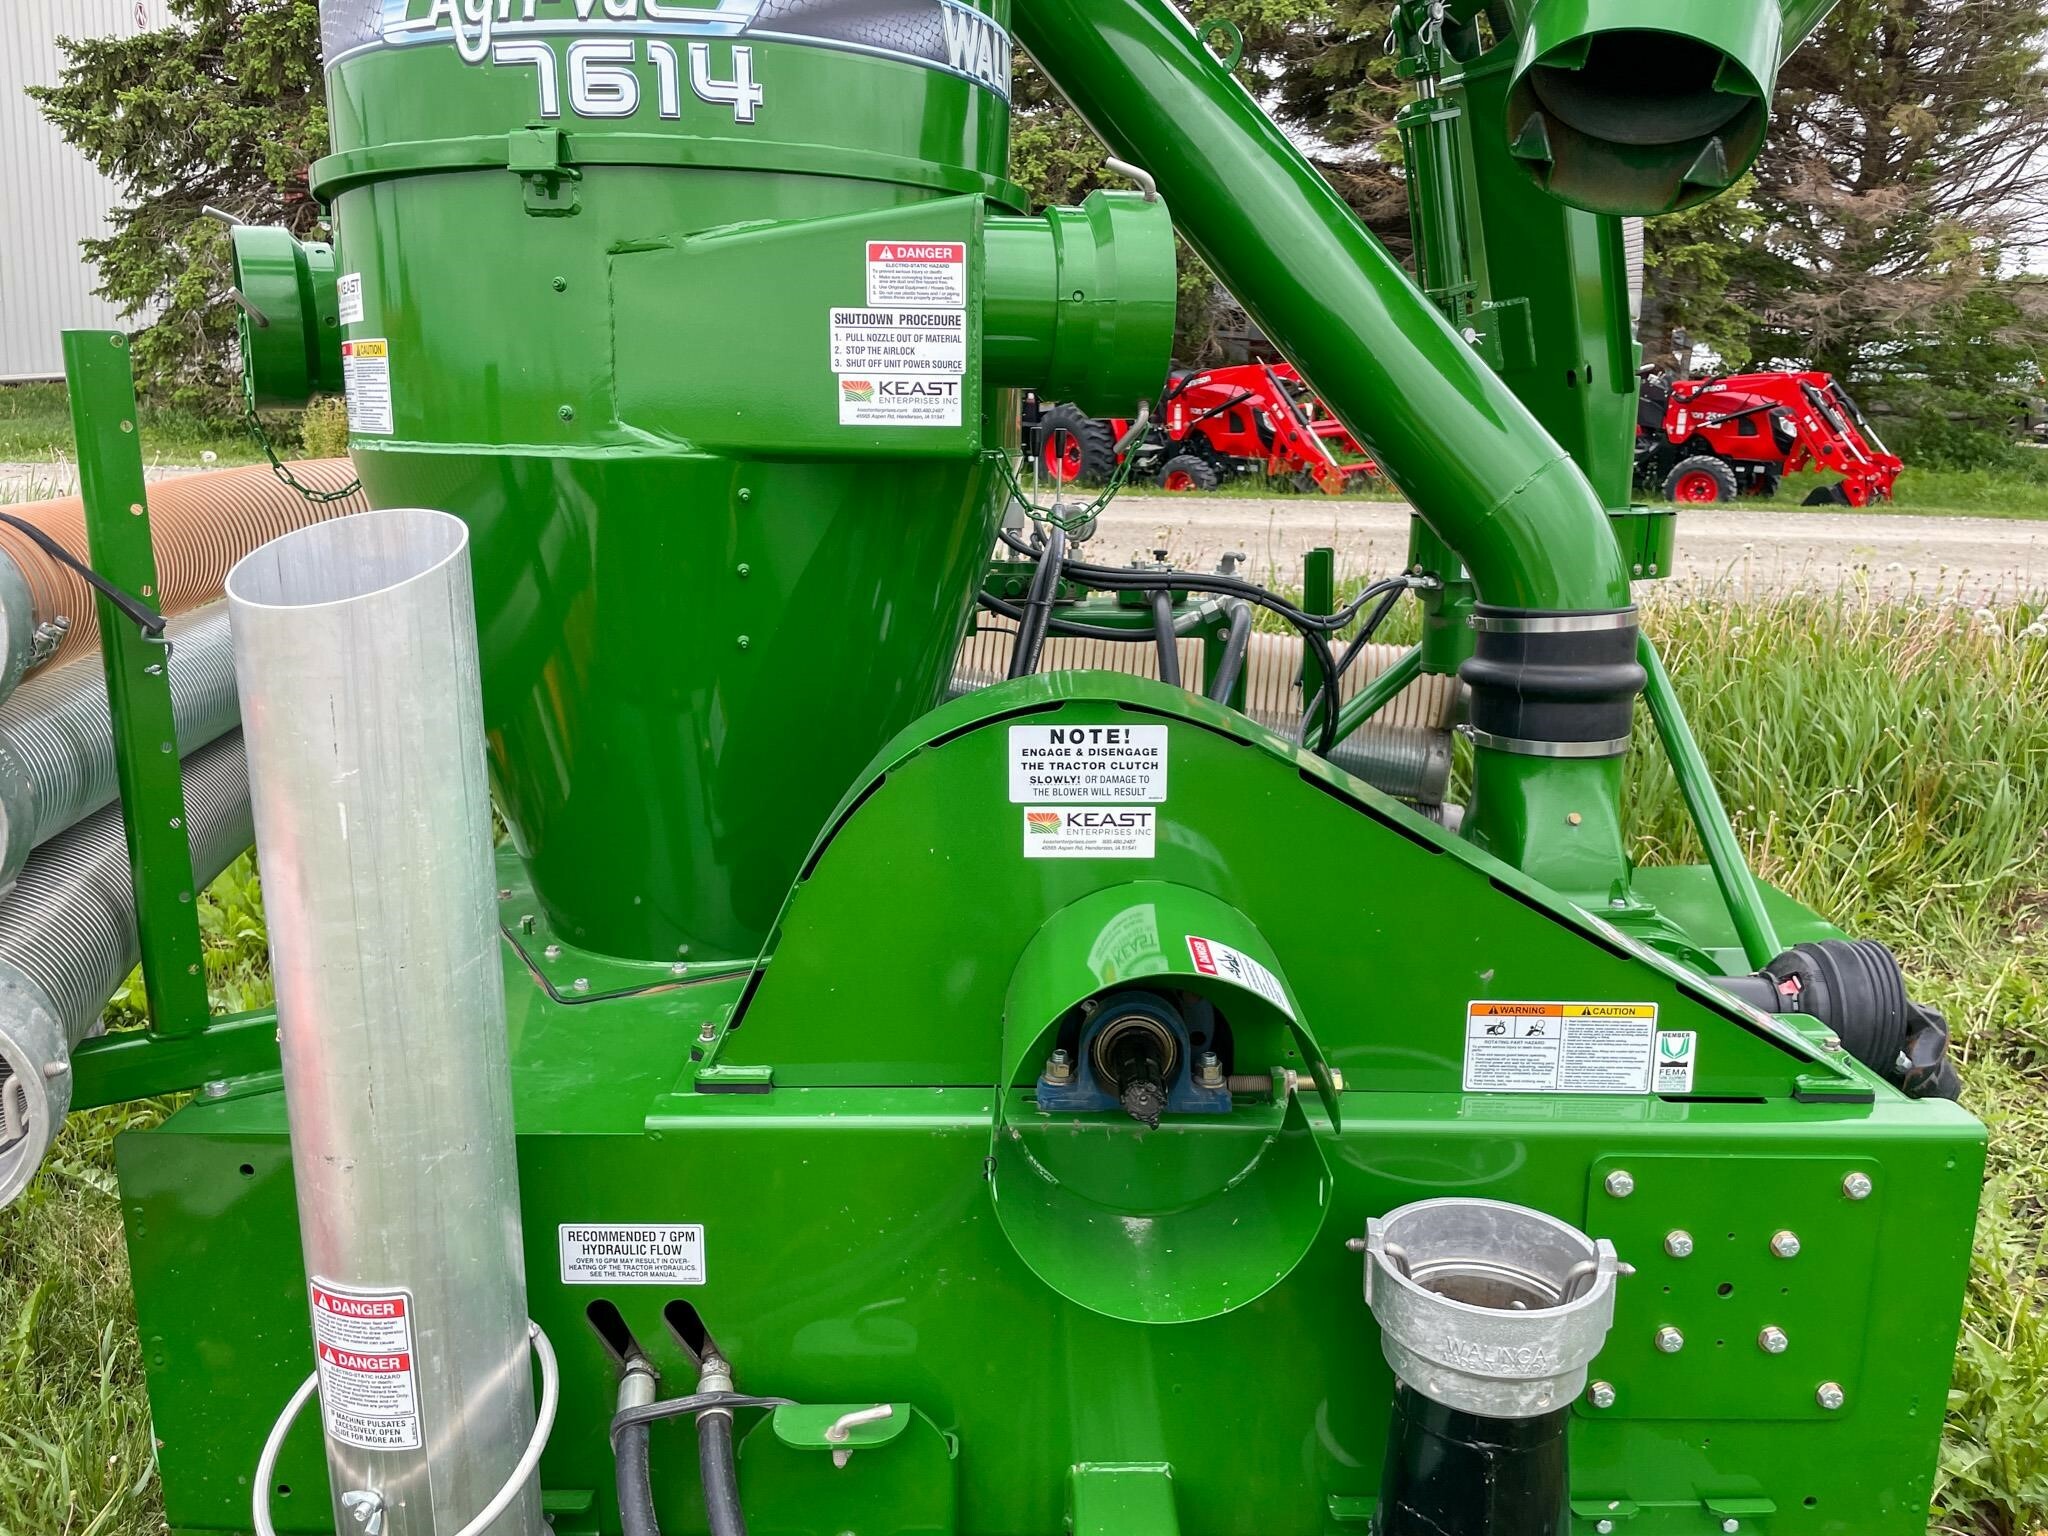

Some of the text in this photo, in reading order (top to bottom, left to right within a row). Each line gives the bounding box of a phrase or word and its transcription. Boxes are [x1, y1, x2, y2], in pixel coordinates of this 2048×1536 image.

[492, 39, 763, 122] 7614
[896, 247, 953, 259] DANGER
[834, 313, 962, 326] SHUTDOWN PROCEDURE
[834, 333, 962, 343] 1. PULL NOZZLE OUT OF MATERIAL
[834, 346, 916, 355] 2. STOP THE AIRLOCK
[834, 359, 962, 369] 3. SHUT OFF UNIT POWER SOURCE
[879, 381, 958, 396] KEAST
[1050, 728, 1130, 744] NOTE!
[1022, 748, 1158, 756] ENGAGE & DISENGAGE
[1021, 762, 1159, 770] THE TRACTOR CLUTCH
[1029, 776, 1150, 784] SLOWLY! OR DAMAGE TO
[1034, 788, 1146, 796] THE BLOWER WILL RESULT
[1067, 813, 1152, 827] KEAST
[1194, 940, 1211, 963] DANGER
[1500, 1006, 1545, 1015] WARNING
[1593, 1007, 1636, 1016] CAUTION
[568, 1231, 696, 1242] RECOMMENDED 7 GPM
[582, 1244, 682, 1255] HYDRAULIC FLOW
[332, 1299, 395, 1316] DANGER
[1446, 1335, 1547, 1364] WALINGA
[338, 1353, 401, 1370] DANGER
[336, 1411, 365, 1426] MACHINE
[334, 1425, 349, 1439] SLIDE
